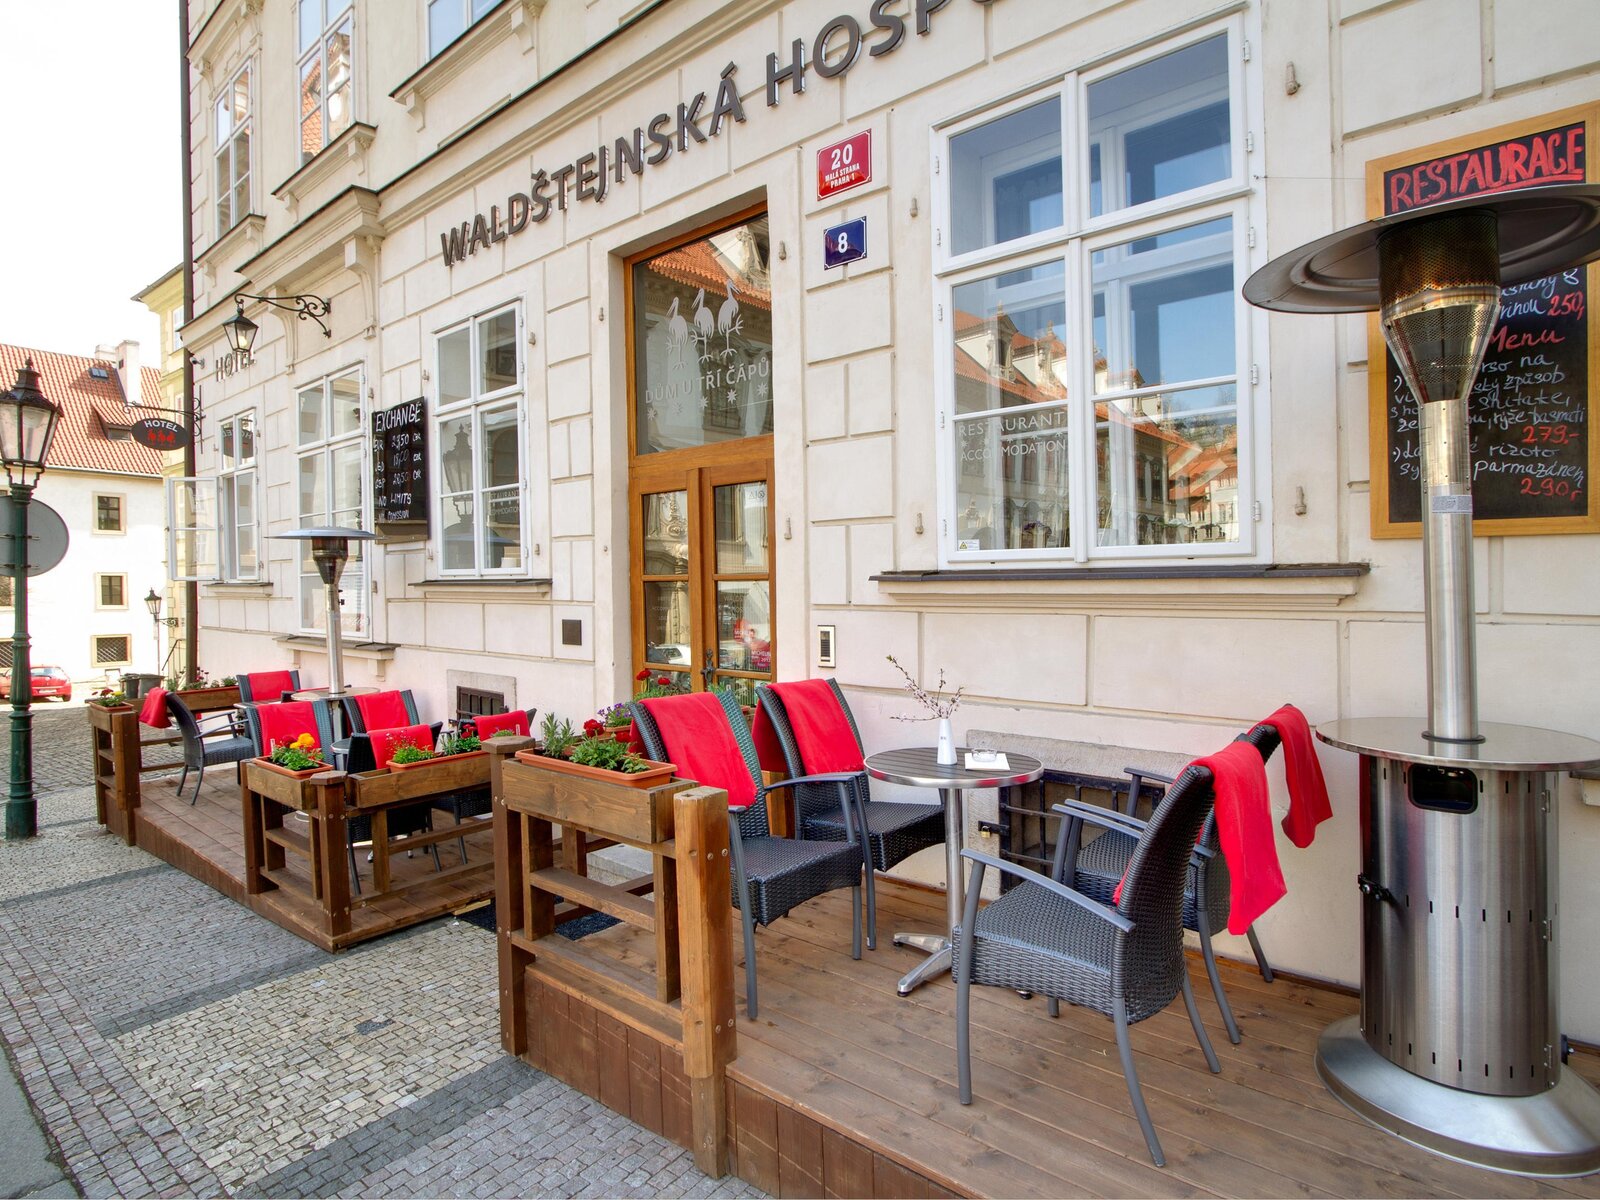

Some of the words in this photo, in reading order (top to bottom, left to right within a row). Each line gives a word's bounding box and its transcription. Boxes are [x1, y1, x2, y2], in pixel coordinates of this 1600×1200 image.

[440, 61, 746, 267] WALDŠTEJNSKÁ
[766, 0, 997, 108] HOSP
[831, 143, 853, 170] 20
[825, 168, 839, 182] MALÁ
[839, 163, 860, 177] STRANA
[830, 174, 850, 189] PRAHA
[1390, 127, 1585, 213] RESTAURACE
[837, 231, 848, 253] 8
[1489, 325, 1566, 352] Menu
[1520, 354, 1555, 368] na
[682, 379, 693, 395] U
[726, 356, 769, 385] ČÁPŮ
[1503, 364, 1566, 394] způsob
[143, 420, 178, 433] HOTEL
[375, 402, 422, 432] EXCHANGE
[960, 439, 1067, 462] ACCOMODATION
[390, 493, 412, 505] LIMITS
